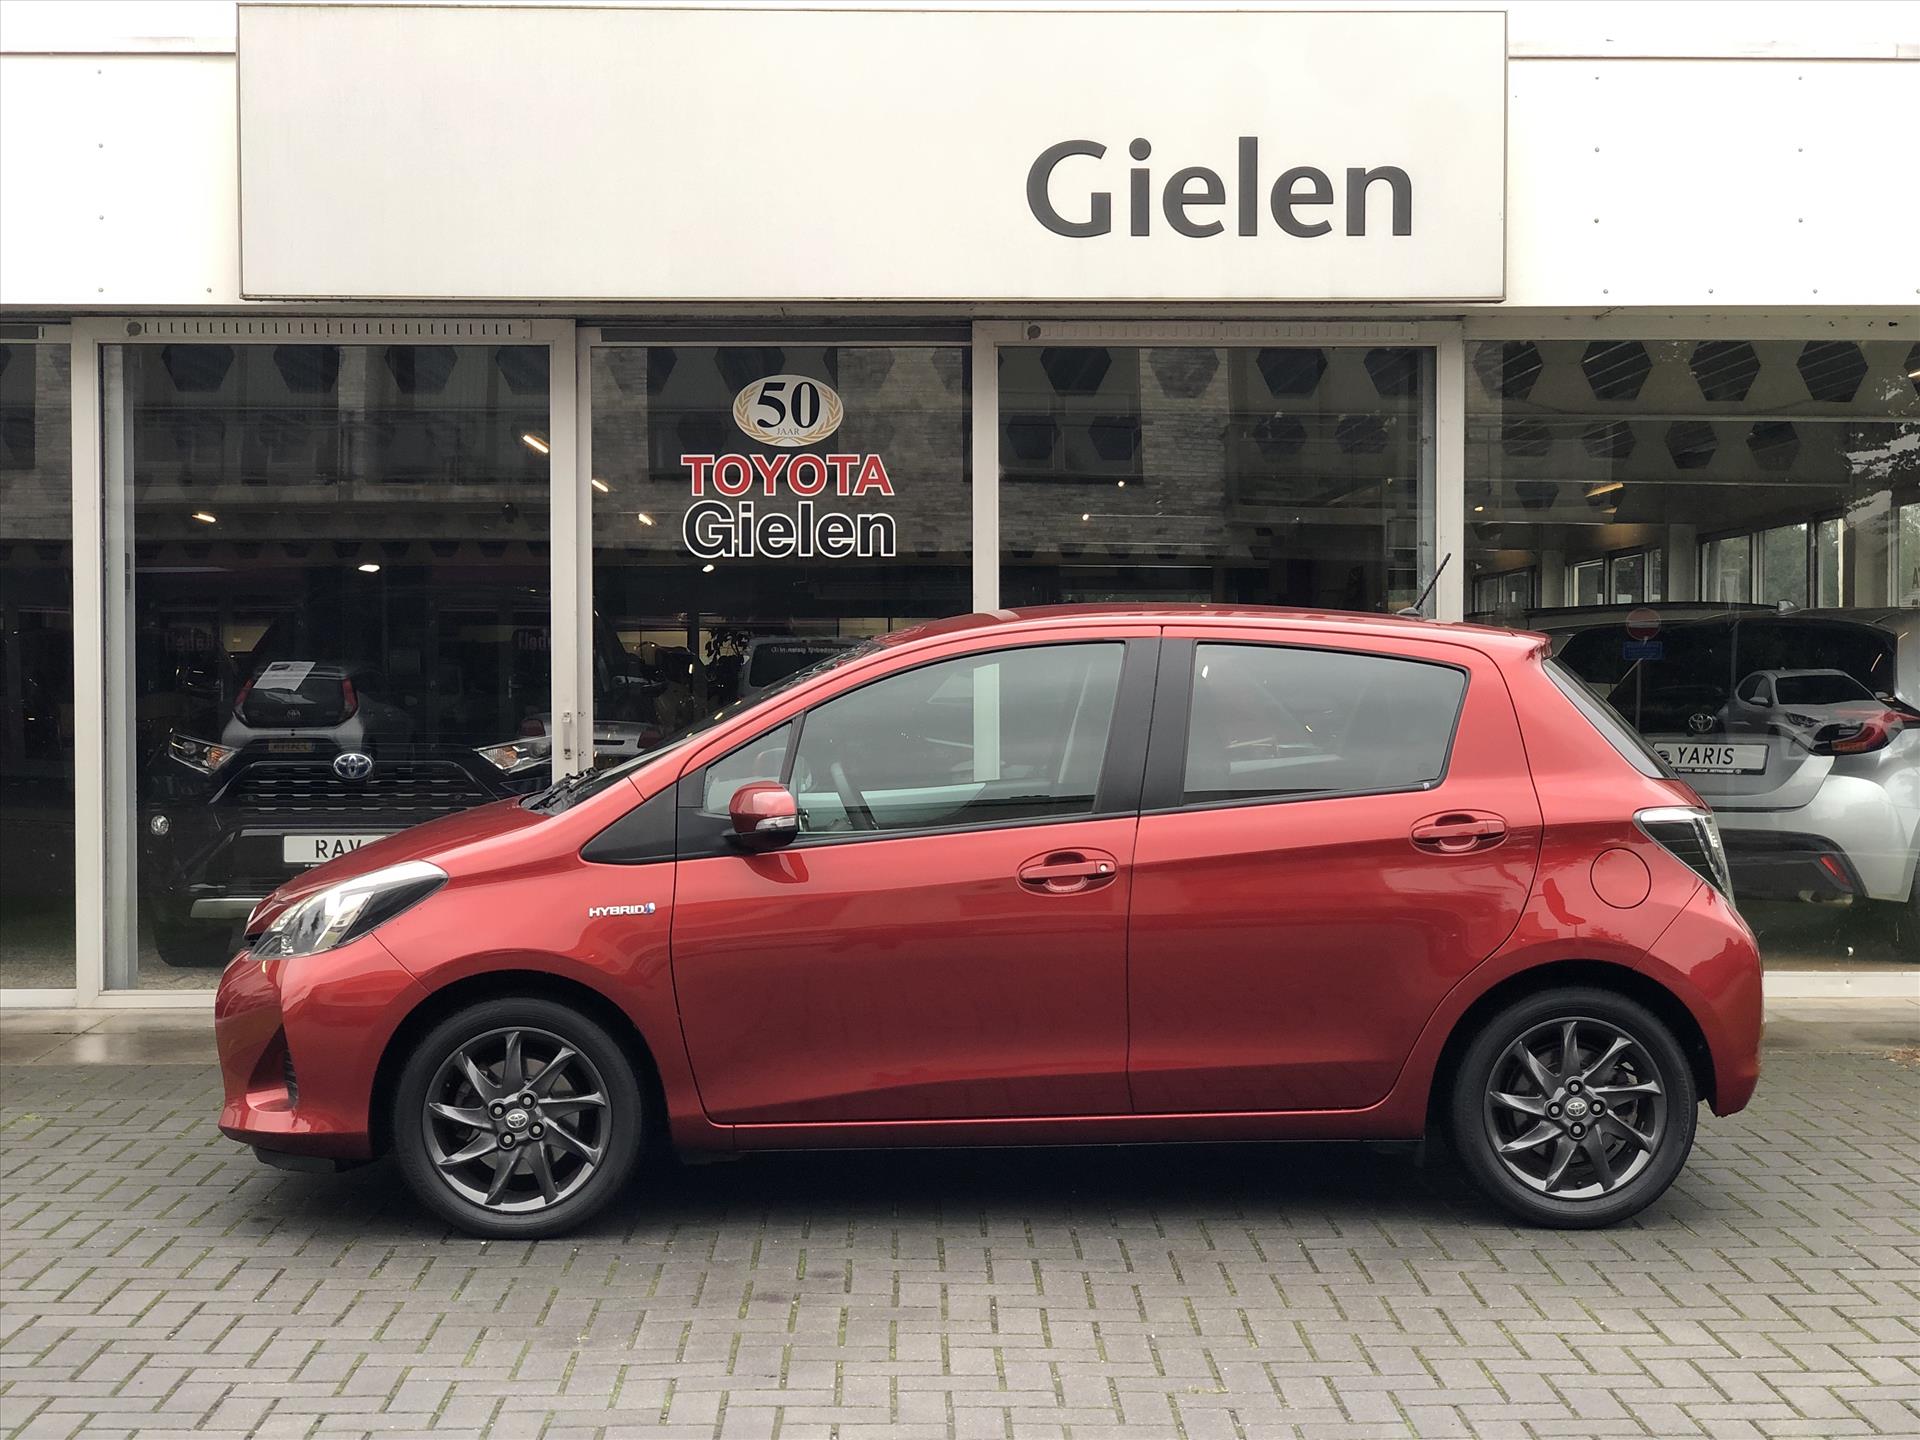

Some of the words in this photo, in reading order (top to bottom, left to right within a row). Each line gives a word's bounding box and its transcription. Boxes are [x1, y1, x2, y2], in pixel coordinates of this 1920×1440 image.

[1026, 136, 1412, 238] Gielen
[756, 381, 821, 429] 50
[776, 427, 800, 436] JAAR
[680, 453, 895, 497] TOYOTA
[682, 499, 896, 558] Gielen
[1678, 746, 1735, 765] YARIS
[588, 904, 645, 917] HYBRID
